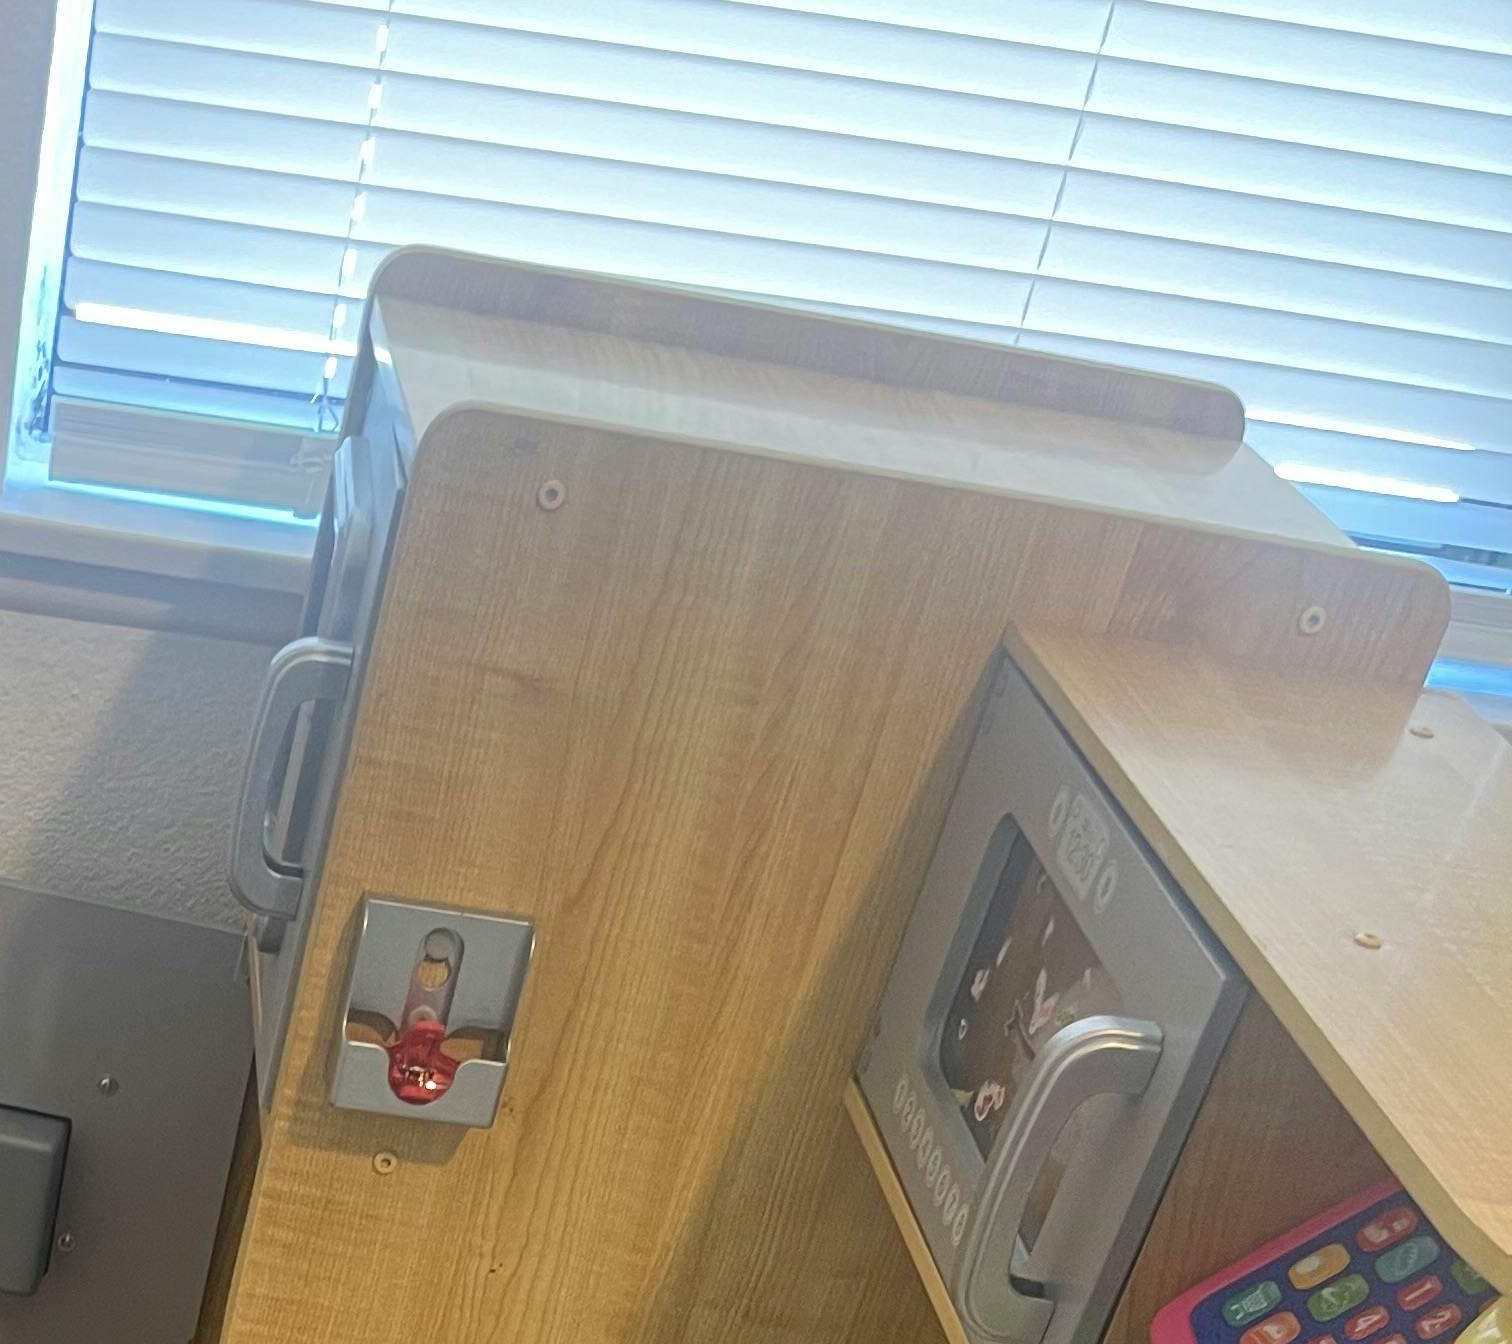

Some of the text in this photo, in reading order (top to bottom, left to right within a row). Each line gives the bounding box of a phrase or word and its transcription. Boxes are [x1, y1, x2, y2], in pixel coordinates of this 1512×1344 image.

[1354, 1311, 1383, 1333] 4
[1404, 1280, 1451, 1335] 1 2
